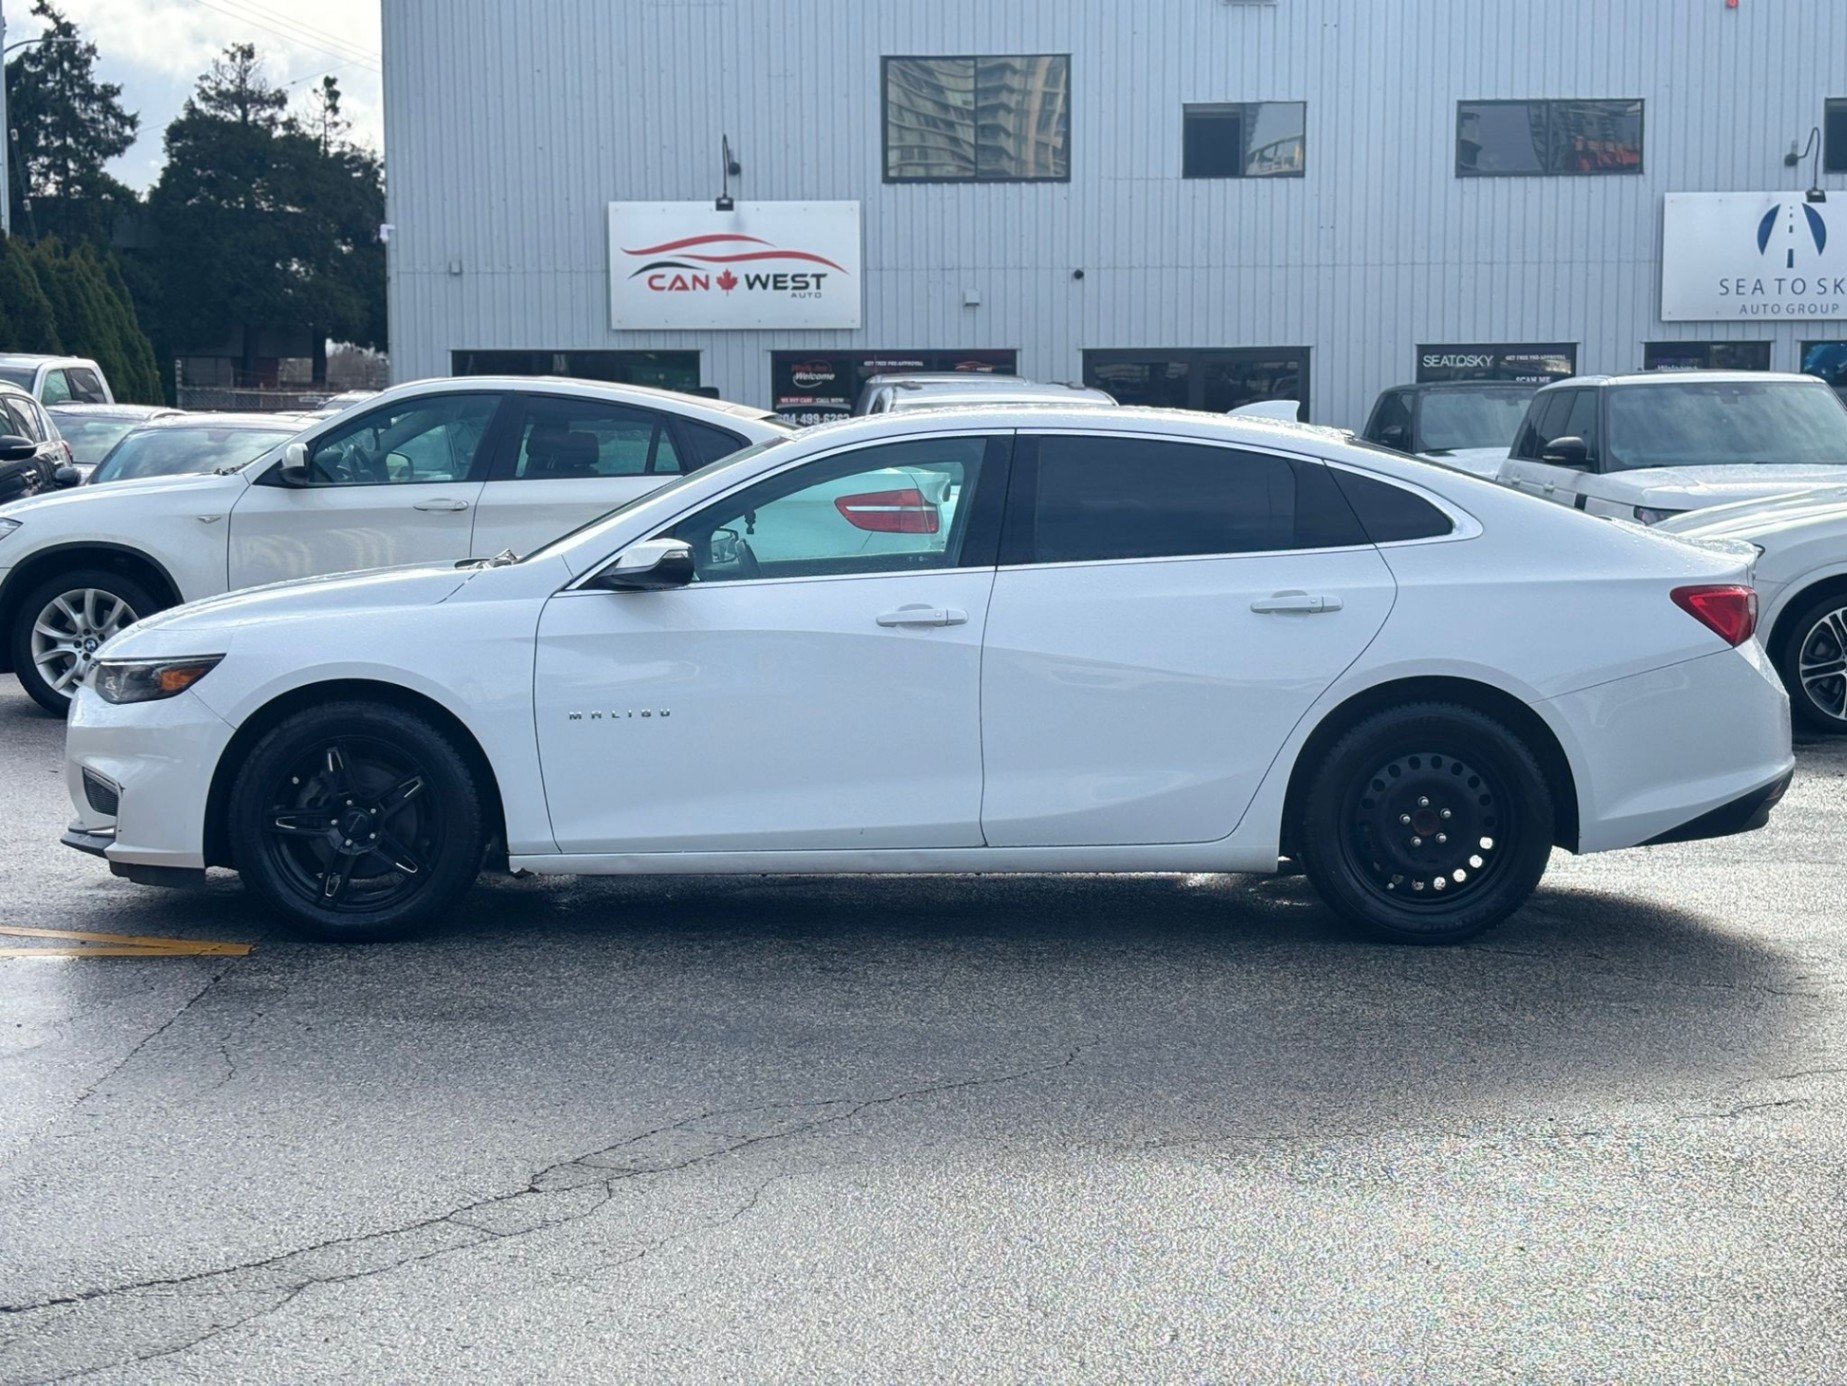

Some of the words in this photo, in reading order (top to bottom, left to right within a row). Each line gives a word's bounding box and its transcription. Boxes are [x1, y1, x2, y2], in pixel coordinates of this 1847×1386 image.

[647, 274, 710, 292] CAN
[744, 273, 828, 291] WEST
[1718, 278, 1765, 296] SEA
[1773, 277, 1807, 296] TO
[790, 291, 822, 299] AUTO
[1739, 303, 1781, 315] AUTO
[1785, 303, 1840, 315] GROUP
[1422, 354, 1494, 368] SEATOSKY
[795, 372, 835, 380] Welcome
[568, 708, 671, 720] MALIBU
